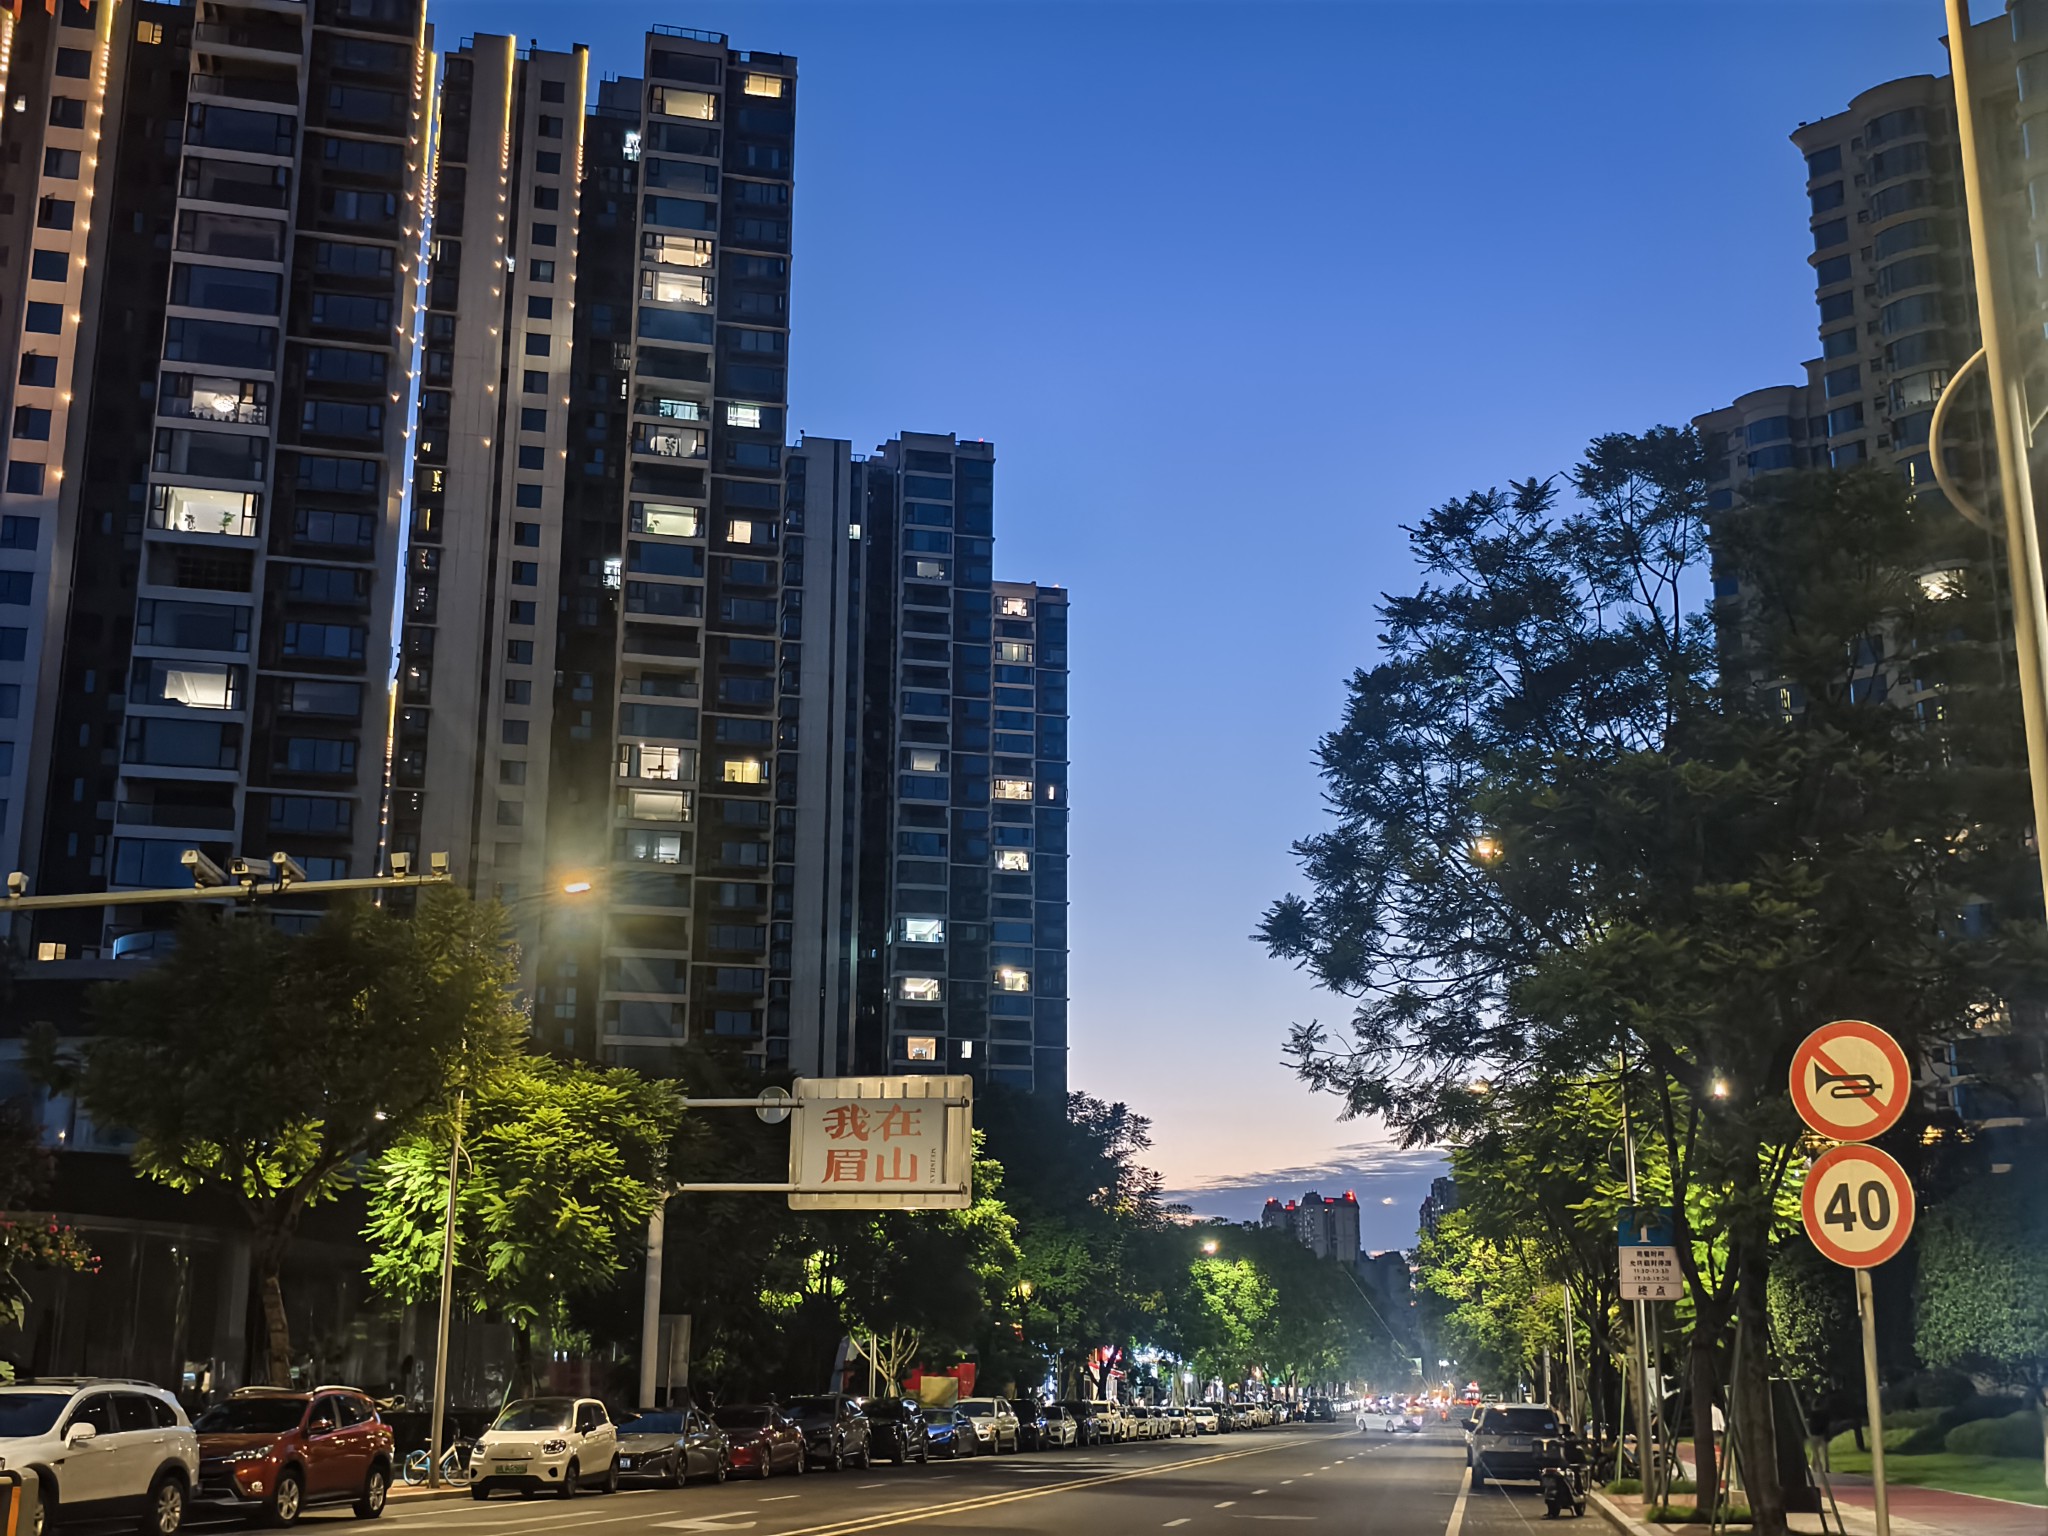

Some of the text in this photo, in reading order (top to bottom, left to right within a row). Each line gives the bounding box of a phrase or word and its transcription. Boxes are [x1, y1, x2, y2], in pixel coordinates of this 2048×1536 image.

[822, 1103, 922, 1142] 我在
[821, 1147, 918, 1183] 眉山
[1824, 1180, 1890, 1232] 40
